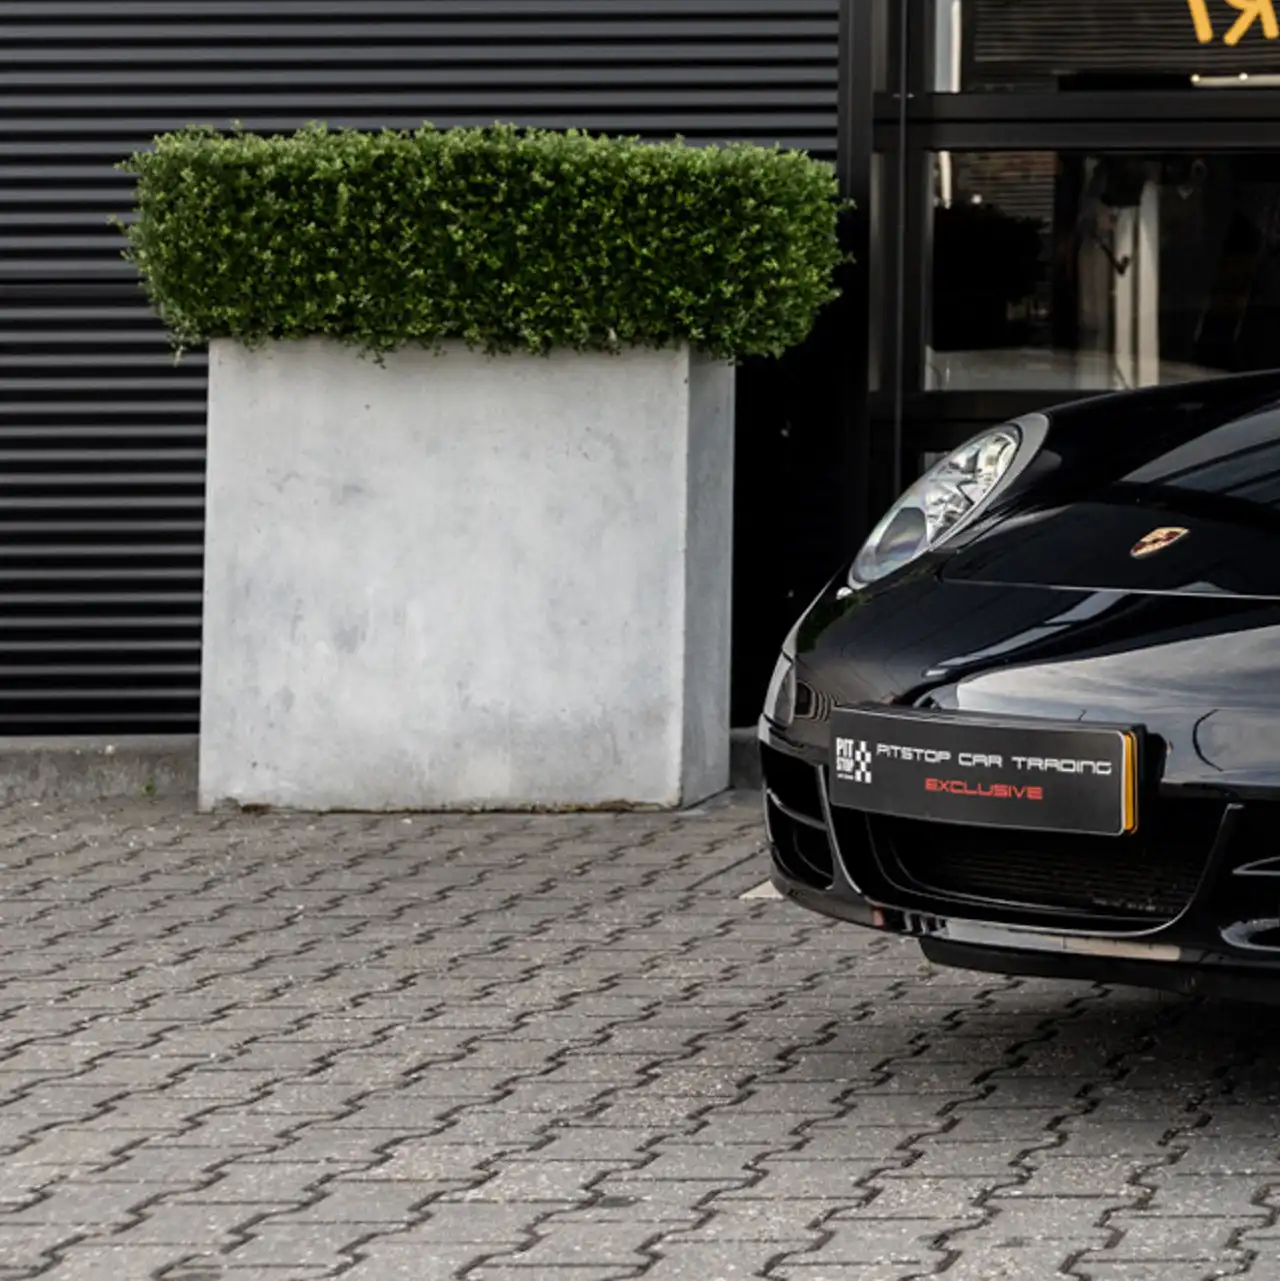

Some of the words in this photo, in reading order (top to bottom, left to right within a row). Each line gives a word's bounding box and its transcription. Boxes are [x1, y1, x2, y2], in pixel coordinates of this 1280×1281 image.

[835, 736, 855, 758] PIT
[876, 743, 952, 764] PITSTOP
[958, 752, 1003, 768] CAR
[1011, 756, 1113, 776] TRADING
[924, 777, 1044, 800] EXCLUSIVE
